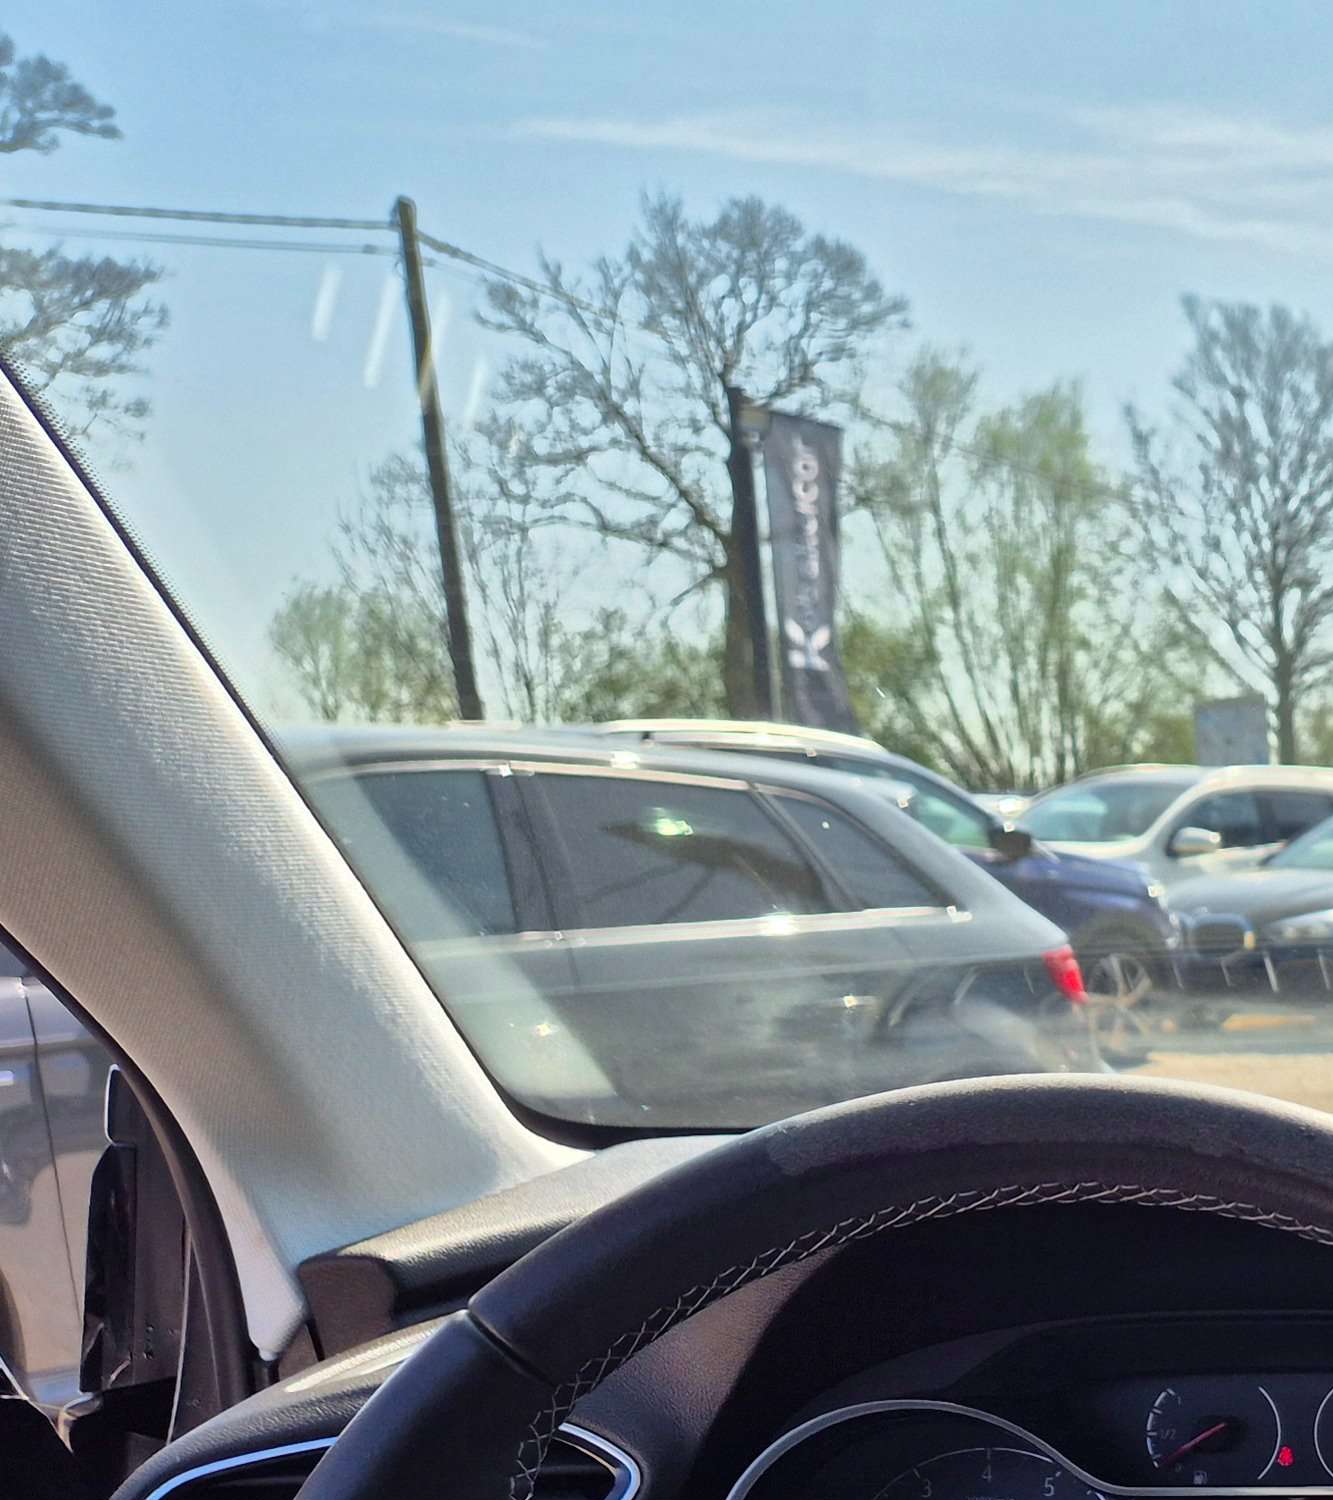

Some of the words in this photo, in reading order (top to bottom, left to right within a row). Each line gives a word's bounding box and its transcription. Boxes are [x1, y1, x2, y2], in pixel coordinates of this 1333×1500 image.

[981, 1464, 993, 1484] 4
[923, 1479, 934, 1498] 3
[1043, 1477, 1055, 1498] 5
